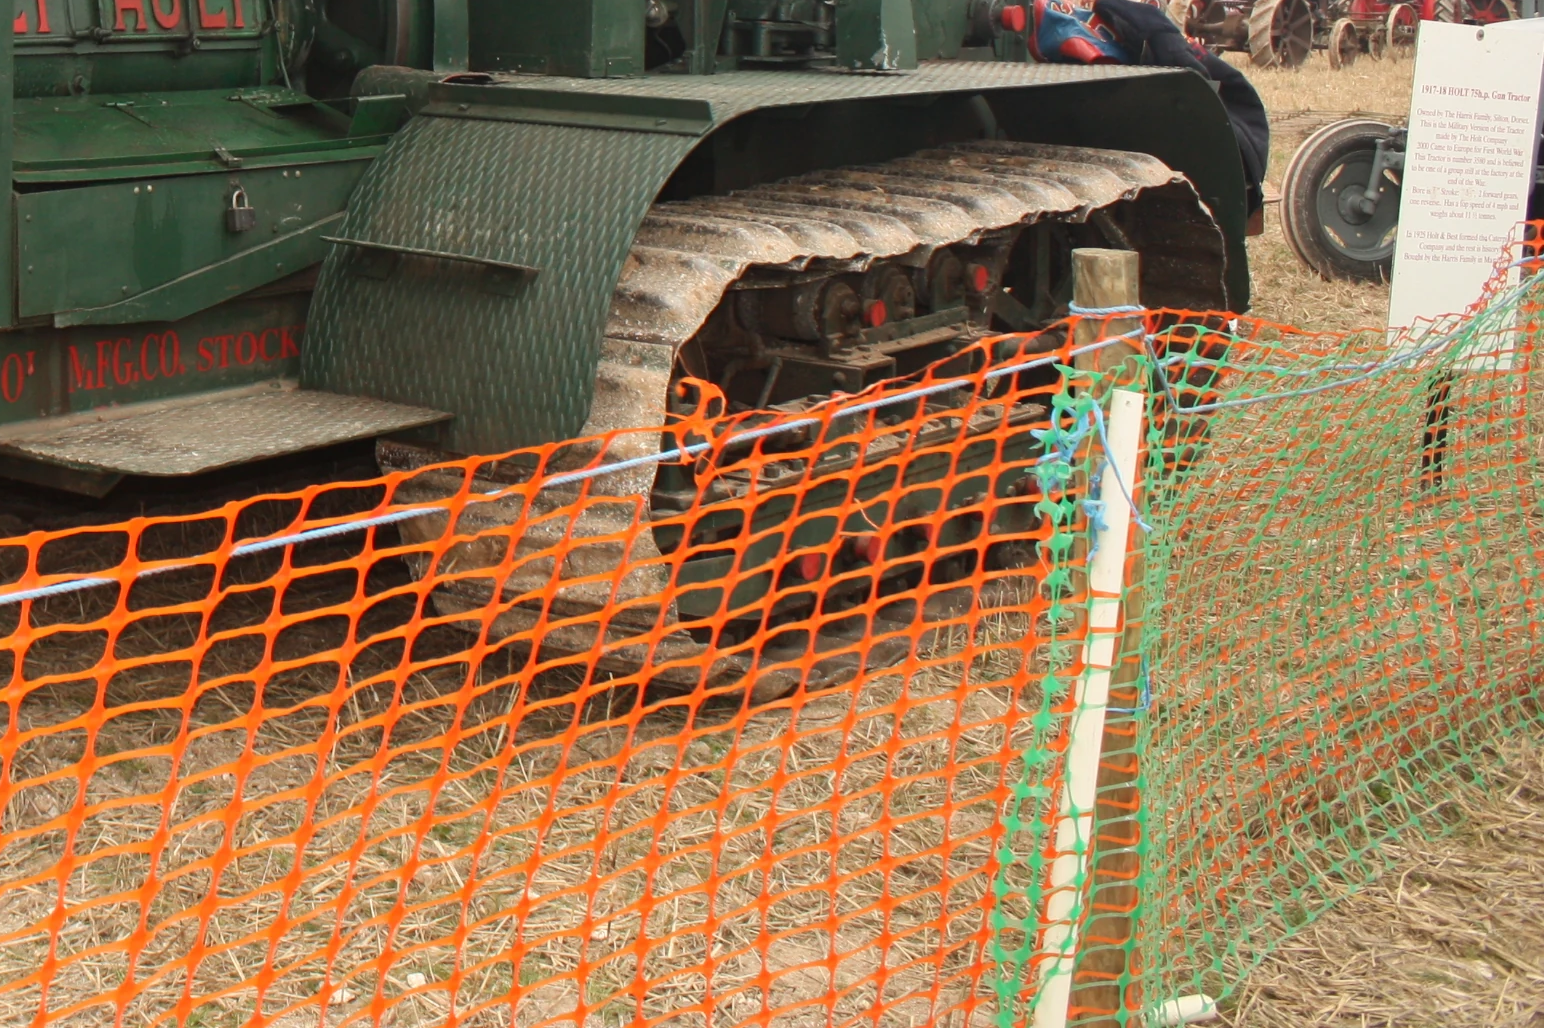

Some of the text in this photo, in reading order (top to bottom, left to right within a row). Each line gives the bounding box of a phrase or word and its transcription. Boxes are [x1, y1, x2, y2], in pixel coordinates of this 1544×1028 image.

[1422, 85, 1531, 102] 1917-18 HOLT 75h.p. Gun Tractor
[1417, 108, 1436, 116] Owned
[1437, 110, 1443, 119] by
[1445, 110, 1455, 118] The
[1456, 111, 1473, 119] Harris
[1448, 122, 1468, 132] Military
[1470, 123, 1489, 132] Version
[1506, 126, 1524, 134] Tractor
[1451, 133, 1456, 142] by
[1470, 134, 1482, 142] Holt
[1483, 136, 1508, 146] Company
[1454, 144, 1473, 154] Europe
[1483, 146, 1494, 154] First
[1415, 152, 1425, 160] This
[1503, 159, 1524, 167] believed
[1448, 168, 1463, 176] group
[1481, 168, 1490, 176] the
[1490, 169, 1508, 179] factory
[1412, 186, 1425, 194] Bore
[1483, 190, 1503, 198] forward
[1460, 200, 1469, 209] top
[1470, 201, 1485, 210] speed
[1497, 202, 1508, 211] mph
[1430, 210, 1448, 219] weighs
[1406, 230, 1412, 238] In
[1447, 232, 1458, 240] Best
[1459, 233, 1478, 241] formed
[1419, 242, 1444, 252] Company
[1404, 253, 1423, 261] Bought
[1424, 253, 1431, 263] by
[1442, 254, 1458, 262] Harris
[1460, 255, 1476, 264] Family
[197, 324, 304, 373] STOCK
